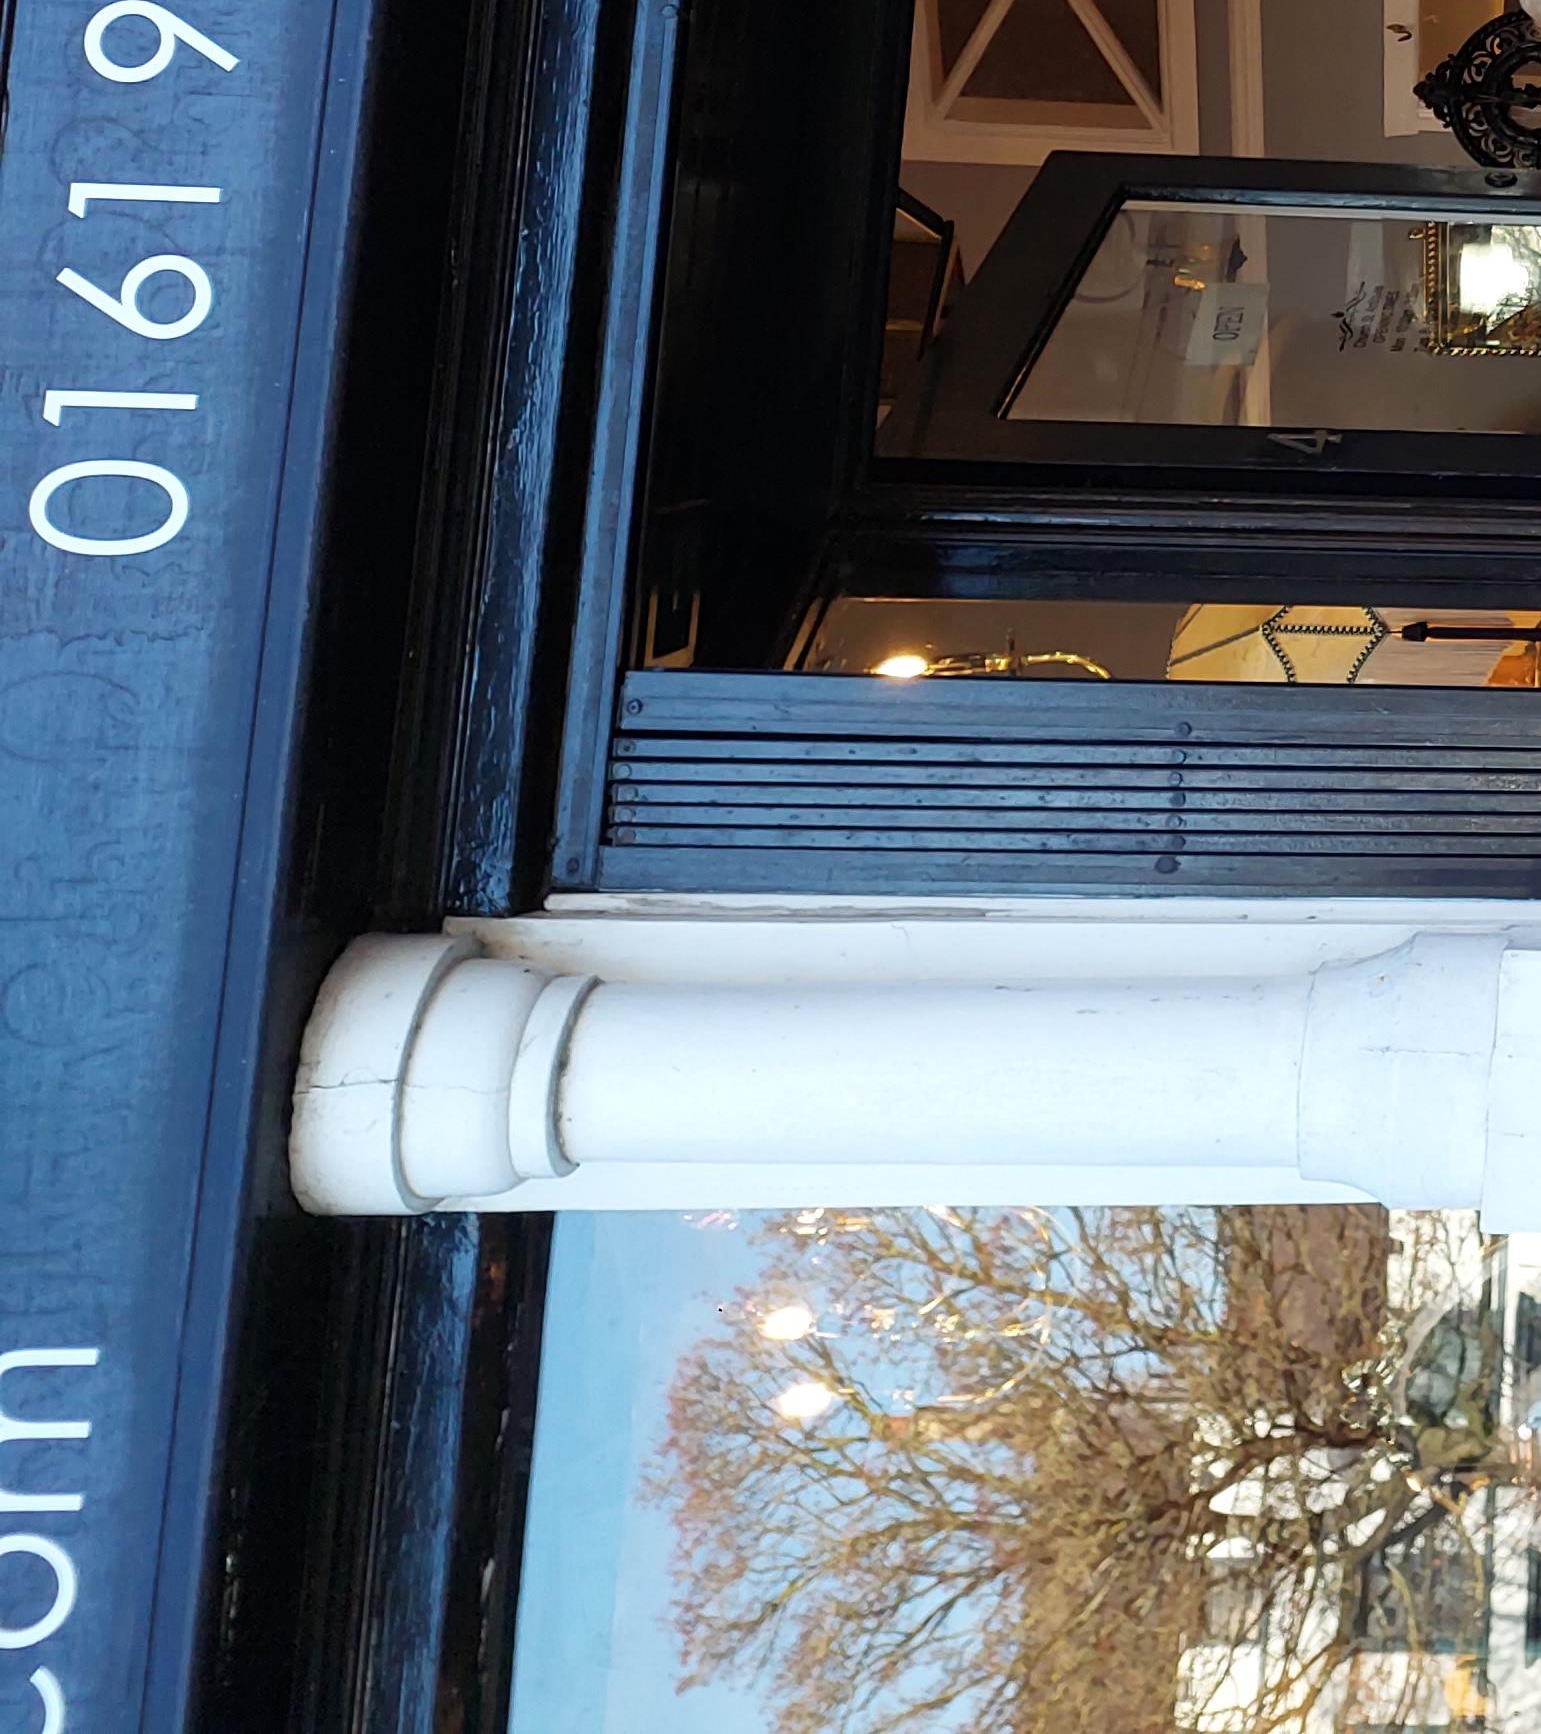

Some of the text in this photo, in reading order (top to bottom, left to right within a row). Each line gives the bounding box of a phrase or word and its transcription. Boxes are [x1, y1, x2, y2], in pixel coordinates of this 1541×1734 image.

[1212, 306, 1245, 341] OPEN
[29, 181, 221, 556] 0161
[1266, 429, 1344, 454] 4
